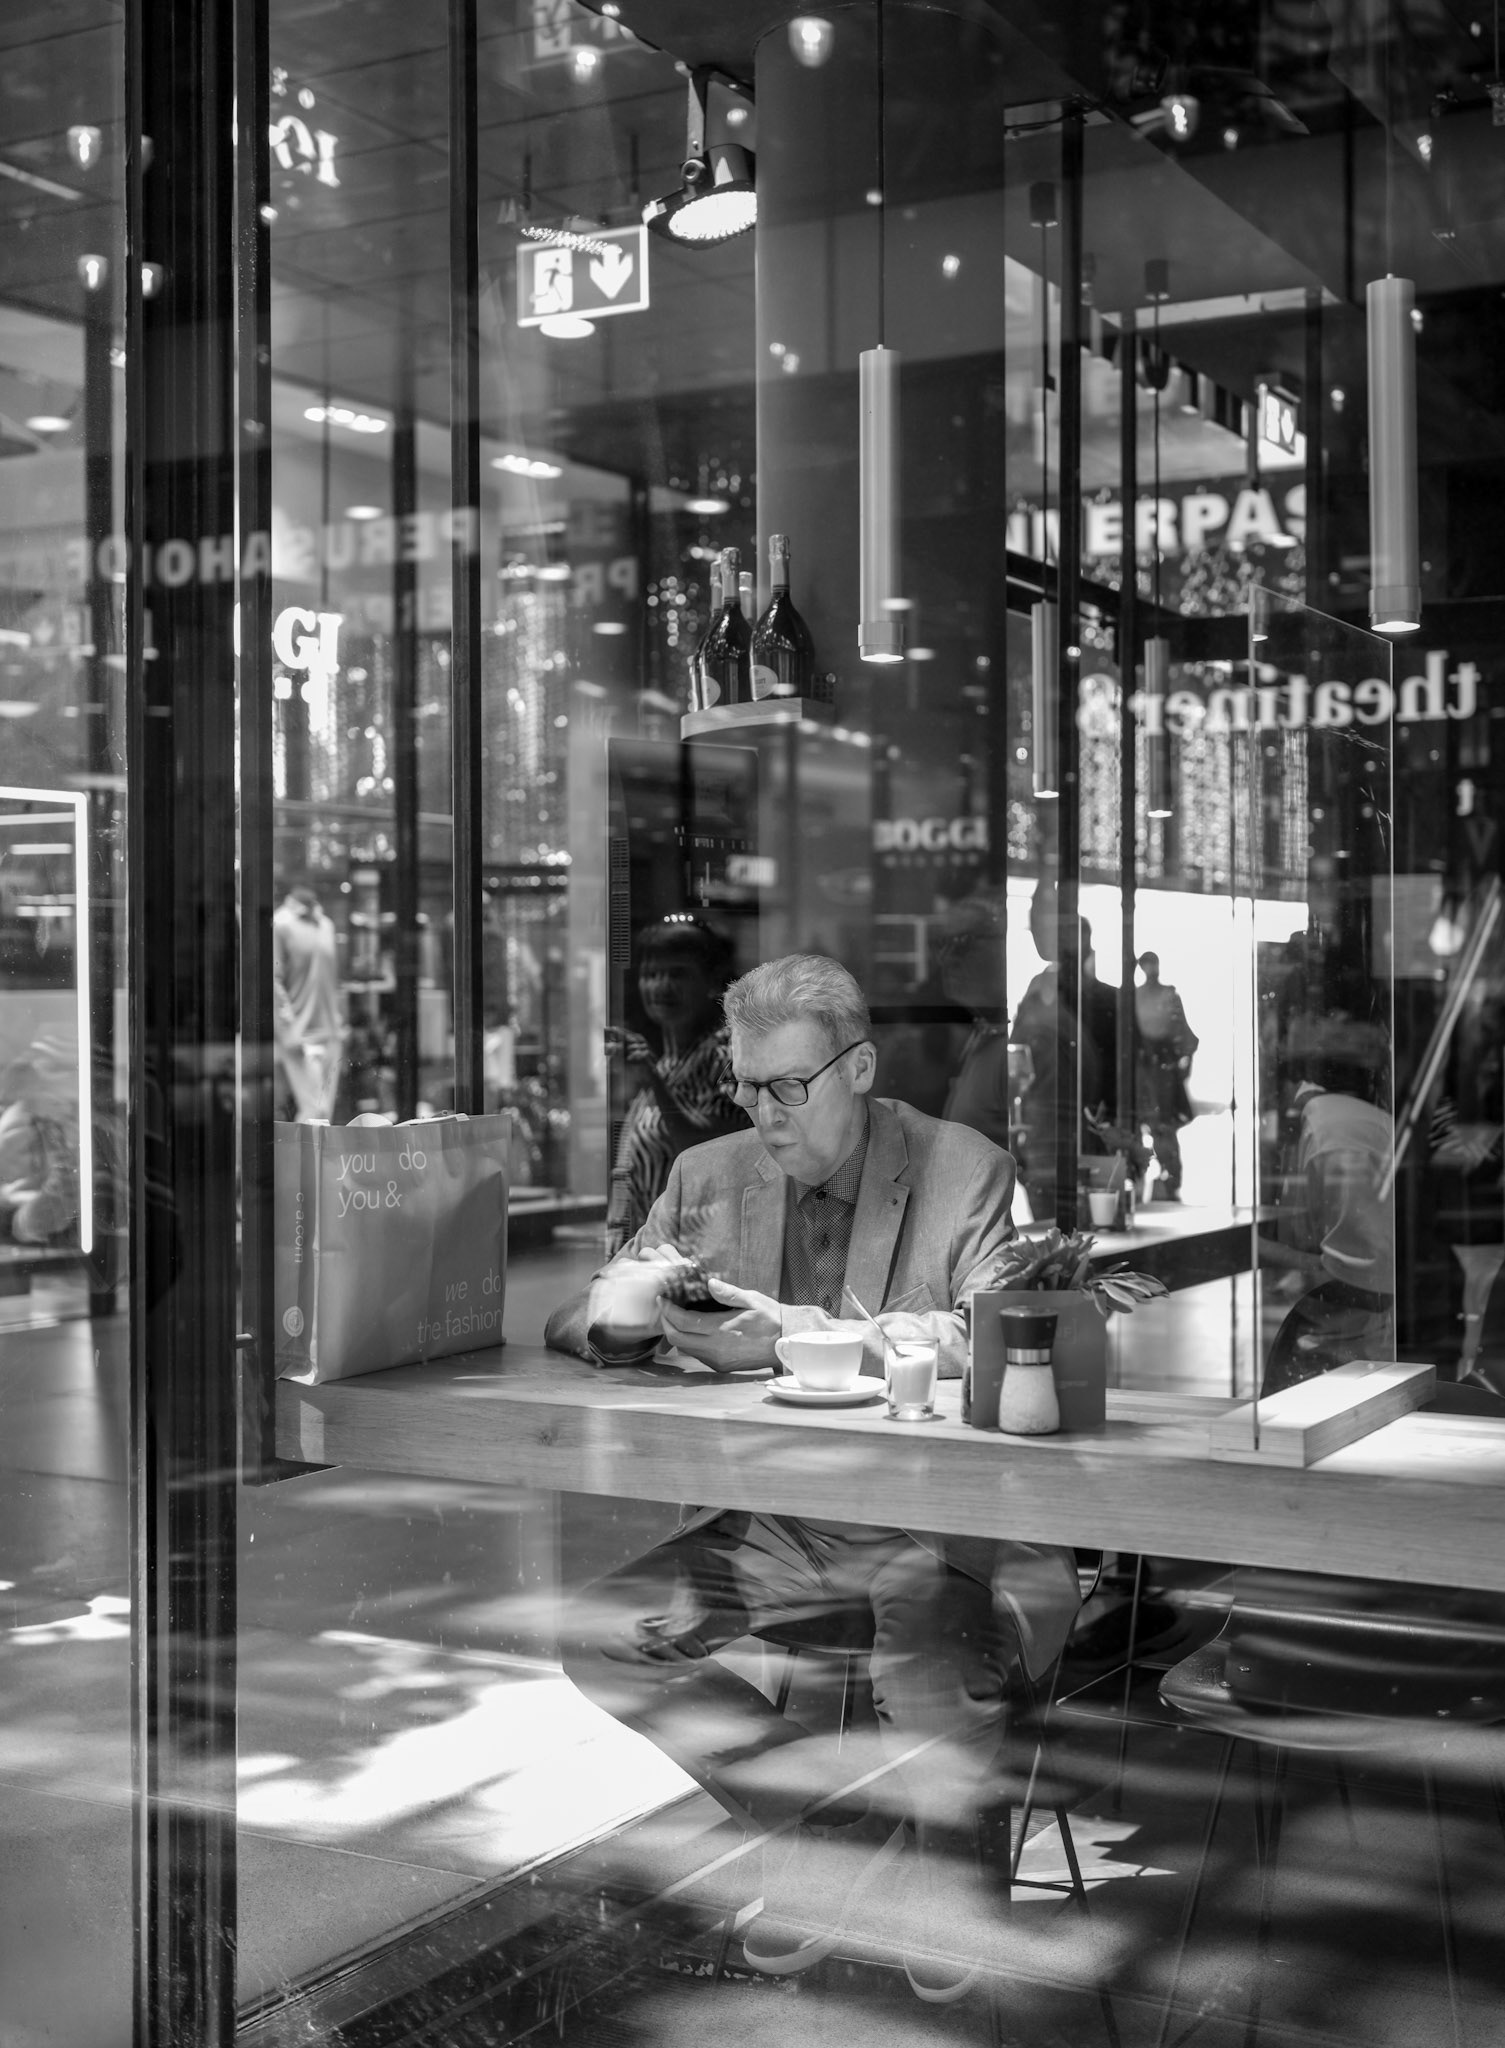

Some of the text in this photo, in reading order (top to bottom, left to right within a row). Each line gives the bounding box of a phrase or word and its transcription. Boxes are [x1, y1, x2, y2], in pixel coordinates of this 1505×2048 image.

[336, 1143, 427, 1181] you do
[336, 1180, 403, 1218] you &
[445, 1268, 501, 1302] we do
[417, 1306, 502, 1344] the fashion
